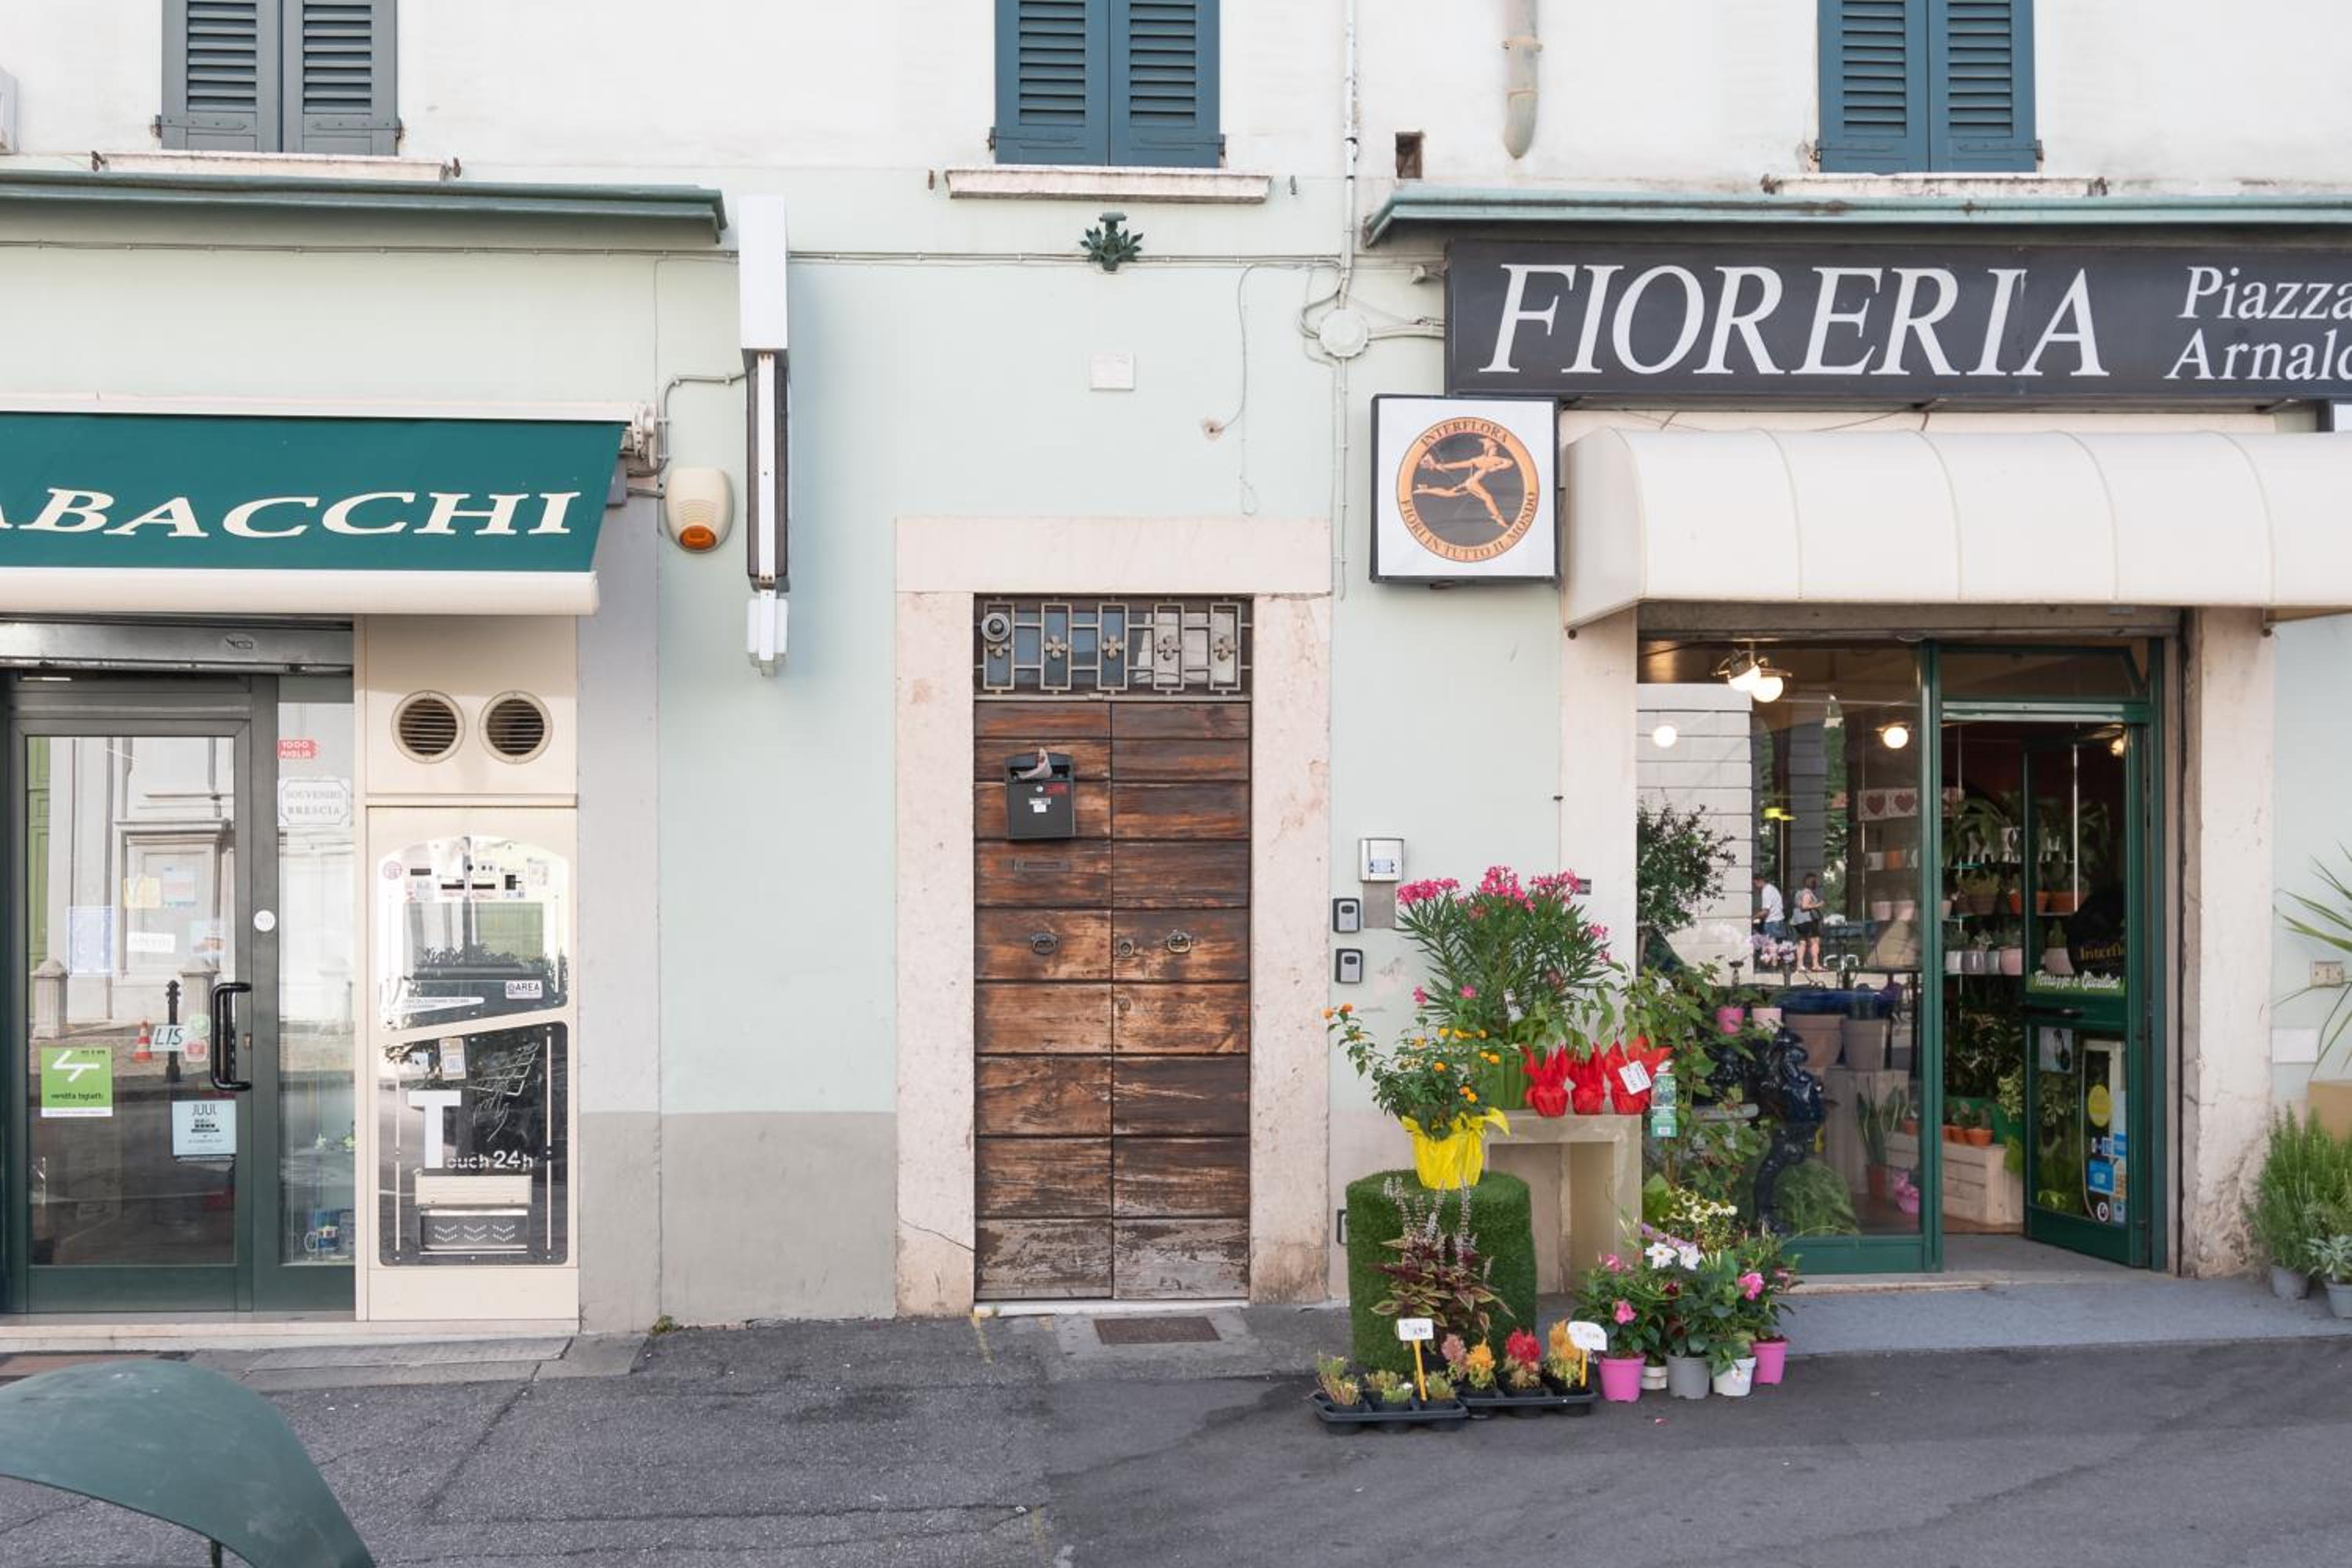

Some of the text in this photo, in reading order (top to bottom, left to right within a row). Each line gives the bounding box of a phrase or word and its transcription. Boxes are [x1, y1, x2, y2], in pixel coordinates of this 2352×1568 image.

[1479, 263, 2110, 377] FIORERIA
[2176, 267, 2352, 320] Piazza
[1421, 420, 1508, 448] INTERFLORA
[0, 488, 581, 539] BACCHI
[1400, 499, 1426, 538] FIORI
[1444, 545, 1490, 560] TUTTO
[1508, 492, 1537, 541] MONDO
